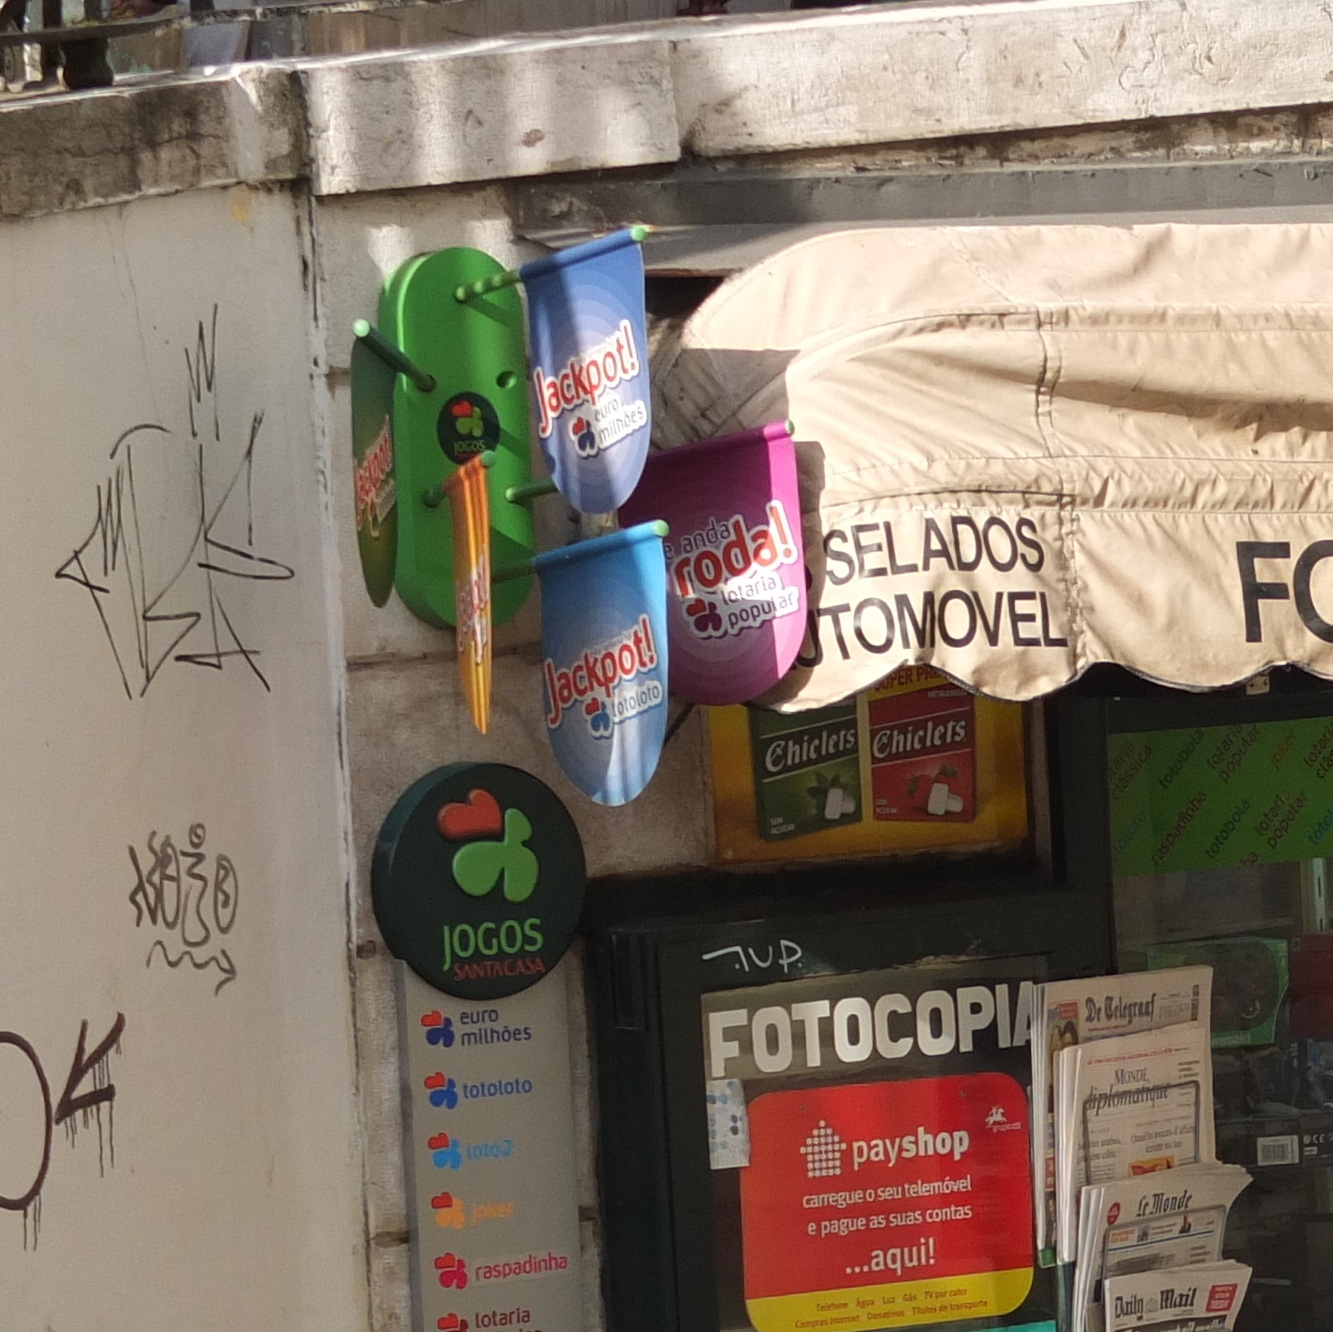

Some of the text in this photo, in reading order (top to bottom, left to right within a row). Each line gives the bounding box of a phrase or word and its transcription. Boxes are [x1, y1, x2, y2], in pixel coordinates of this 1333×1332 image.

[534, 320, 639, 437] Jackpot!
[674, 500, 797, 600] roda!
[680, 519, 731, 556] anda
[823, 516, 1045, 586] SELADOS
[720, 573, 778, 607] lotaria
[727, 590, 798, 636] popular
[793, 589, 1068, 668] UTOMOVEL
[547, 617, 656, 725] Jackpot!
[765, 726, 856, 773] Chiclets
[872, 718, 966, 759] Chiclets
[443, 918, 543, 970] JOGOS
[460, 1009, 498, 1026] euro
[461, 1025, 531, 1046] milhões
[463, 1078, 532, 1099] totoloto
[852, 1126, 970, 1170] payshop
[803, 1175, 972, 1209] carregue o seu telemóvel
[1152, 1192, 1193, 1216] Monde
[808, 1204, 973, 1238] e pague as suas contas
[475, 1251, 568, 1282] raspadinha
[475, 1307, 531, 1329] lotaria
[1114, 1287, 1197, 1320] Daily Mail
